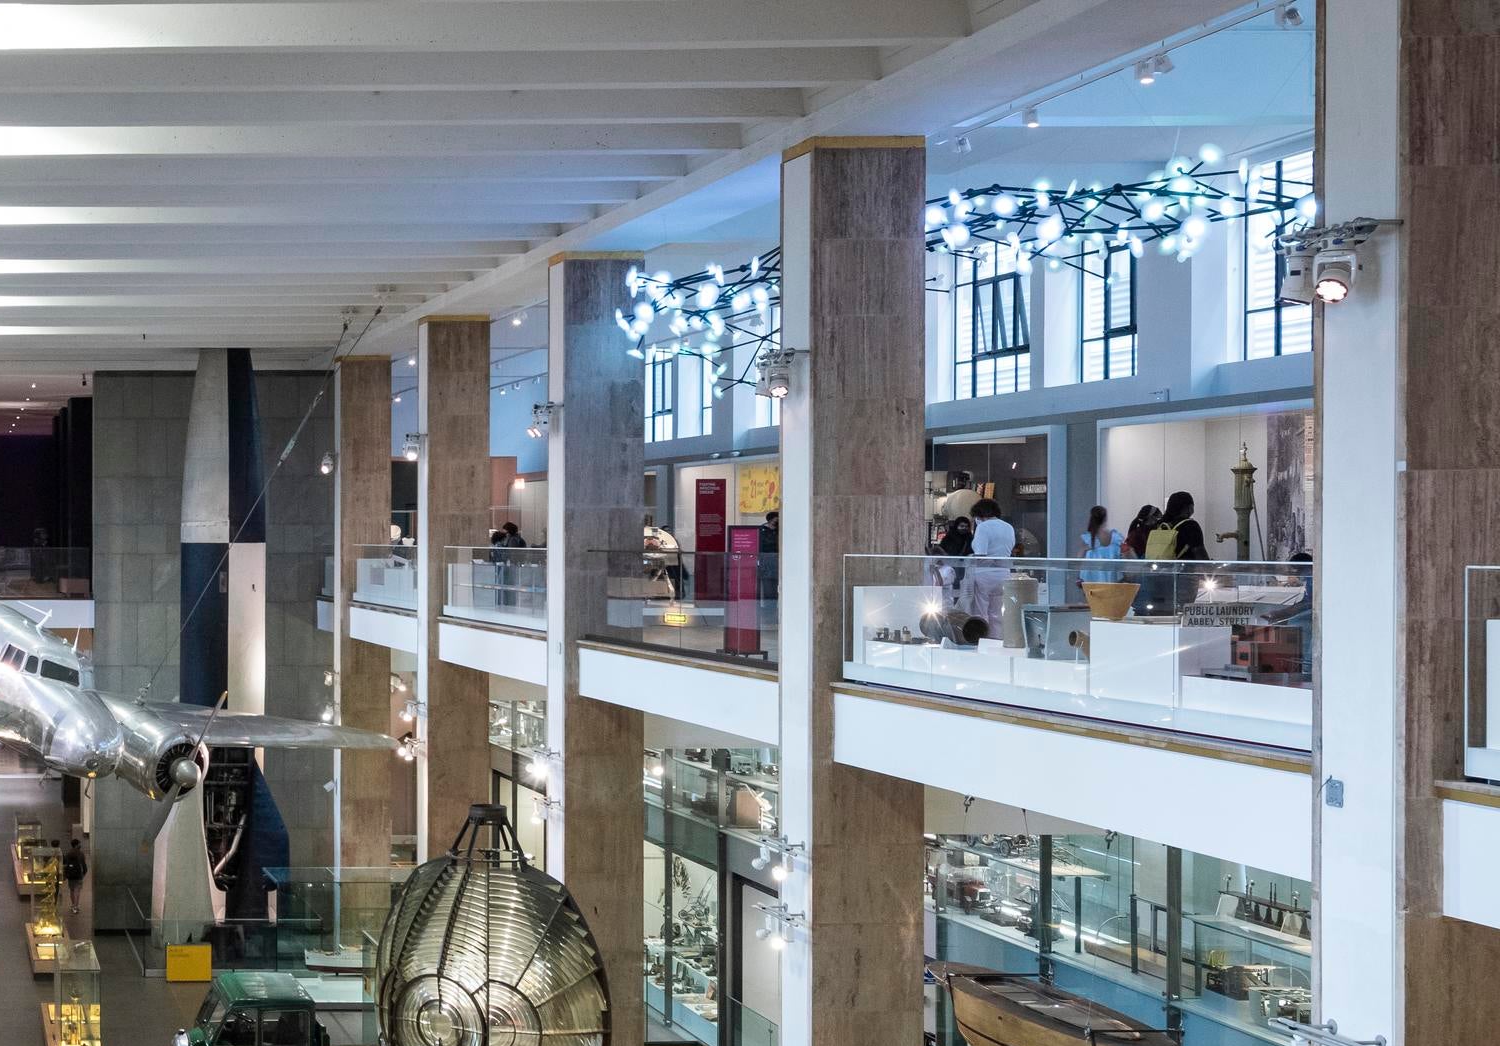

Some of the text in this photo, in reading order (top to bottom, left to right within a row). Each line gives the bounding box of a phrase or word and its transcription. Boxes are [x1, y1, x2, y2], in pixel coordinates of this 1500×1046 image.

[1184, 606, 1254, 616] PUBLIC LAUNDRY
[1188, 617, 1250, 626] ABBEY STREET
